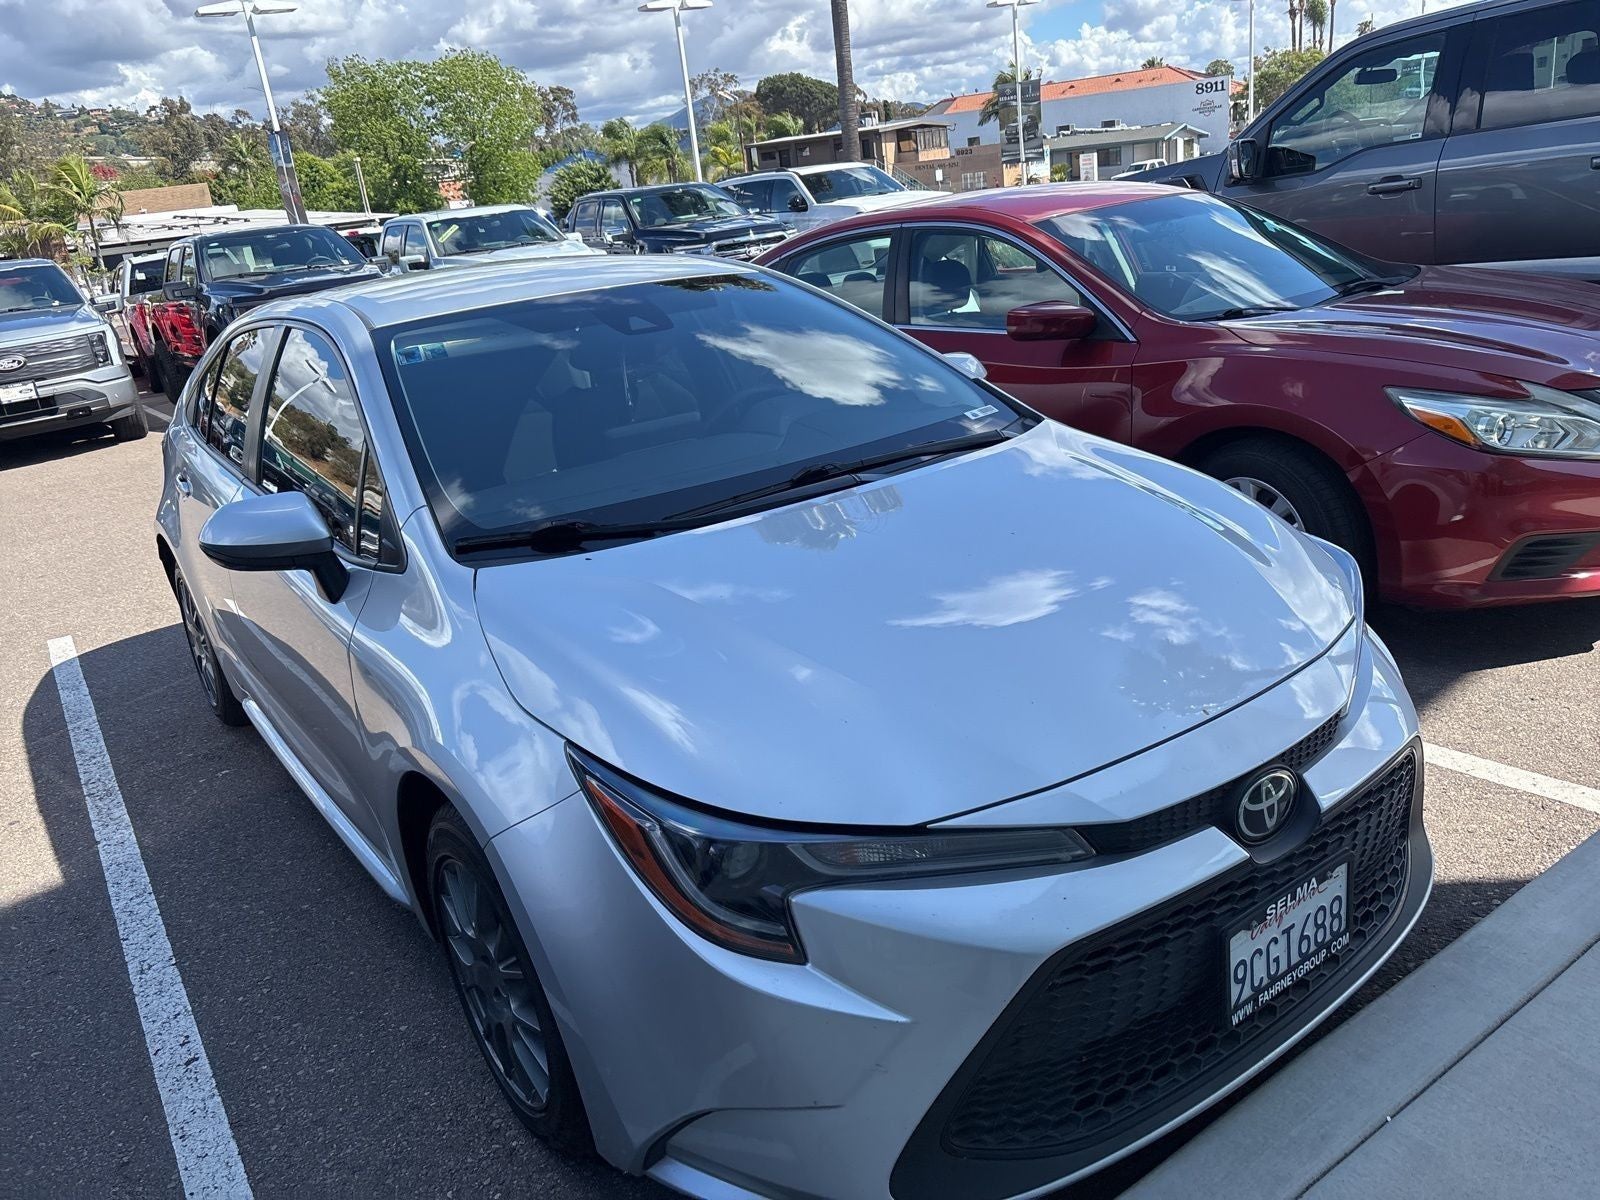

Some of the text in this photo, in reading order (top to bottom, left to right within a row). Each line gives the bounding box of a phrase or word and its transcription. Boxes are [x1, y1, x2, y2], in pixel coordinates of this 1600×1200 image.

[1195, 80, 1226, 94] 8911
[1265, 877, 1319, 920] SELMA
[1232, 894, 1343, 1010] 9CGT688
